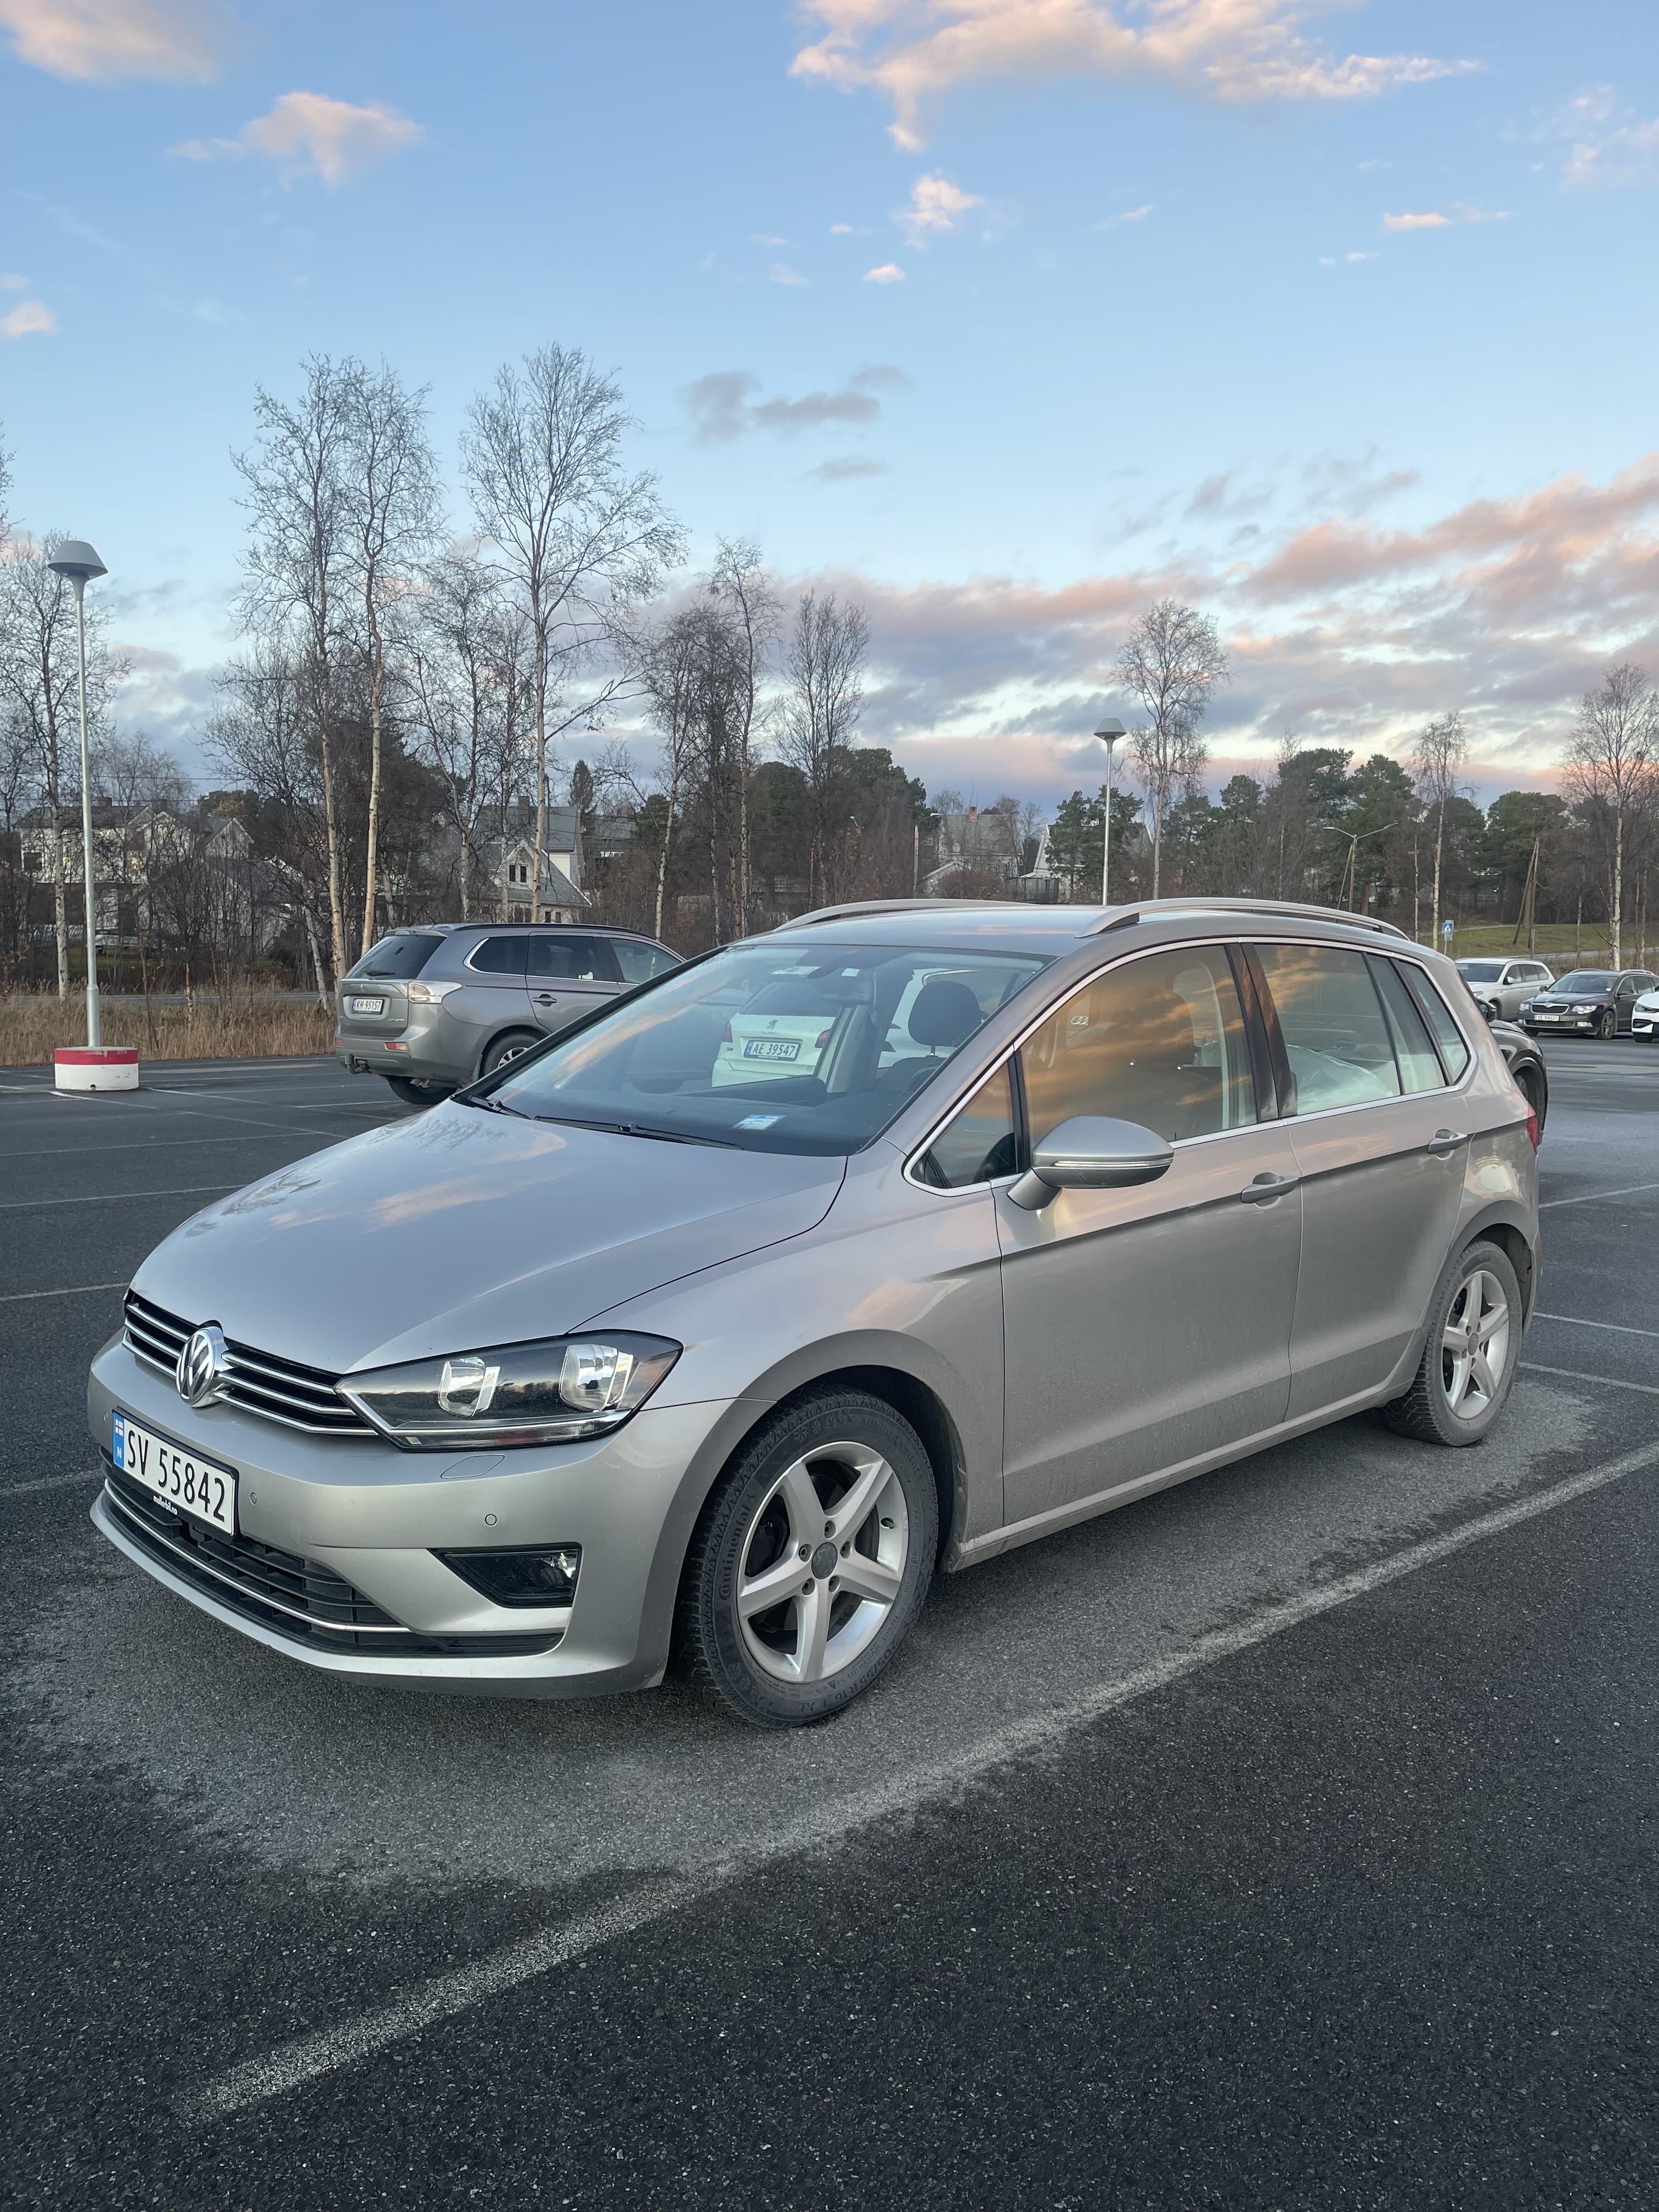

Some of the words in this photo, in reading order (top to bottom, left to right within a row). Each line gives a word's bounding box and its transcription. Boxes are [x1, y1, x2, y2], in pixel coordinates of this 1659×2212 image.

[356, 1001, 364, 1009] KH
[364, 1001, 381, 1010] 95157
[753, 1043, 765, 1054] AE
[766, 1044, 795, 1056] 39547
[117, 1446, 122, 1459] N
[128, 1430, 149, 1476] SV
[158, 1447, 225, 1522] 55842
[719, 1504, 751, 1600] Continental
